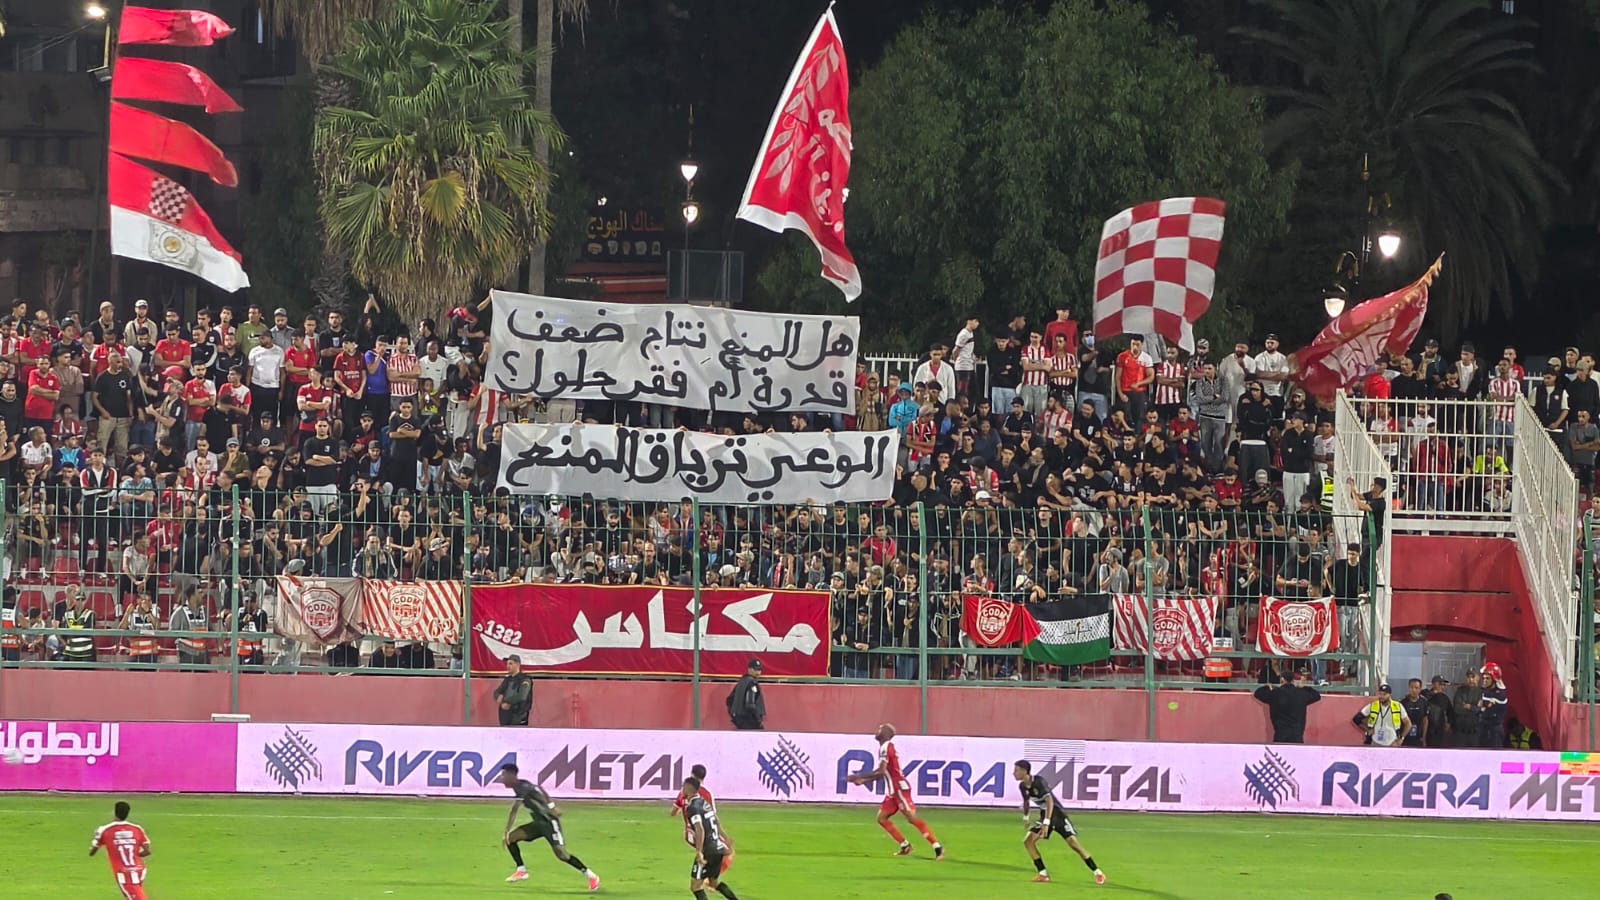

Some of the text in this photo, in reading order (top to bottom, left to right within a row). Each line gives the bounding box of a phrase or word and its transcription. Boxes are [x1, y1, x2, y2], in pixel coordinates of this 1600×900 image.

[507, 309, 854, 371] هل المنع نتاج ضعف
[601, 360, 687, 400] فقر
[709, 356, 746, 411] أم
[748, 367, 848, 412] قدرة
[505, 427, 890, 502] الوعي ترياق المنع
[307, 603, 333, 613] CODM
[393, 596, 420, 604] CODM
[480, 589, 821, 666] مكناس
[0, 721, 119, 764] البطول
[1321, 761, 1491, 811] RIVERA
[118, 844, 136, 867] 17
